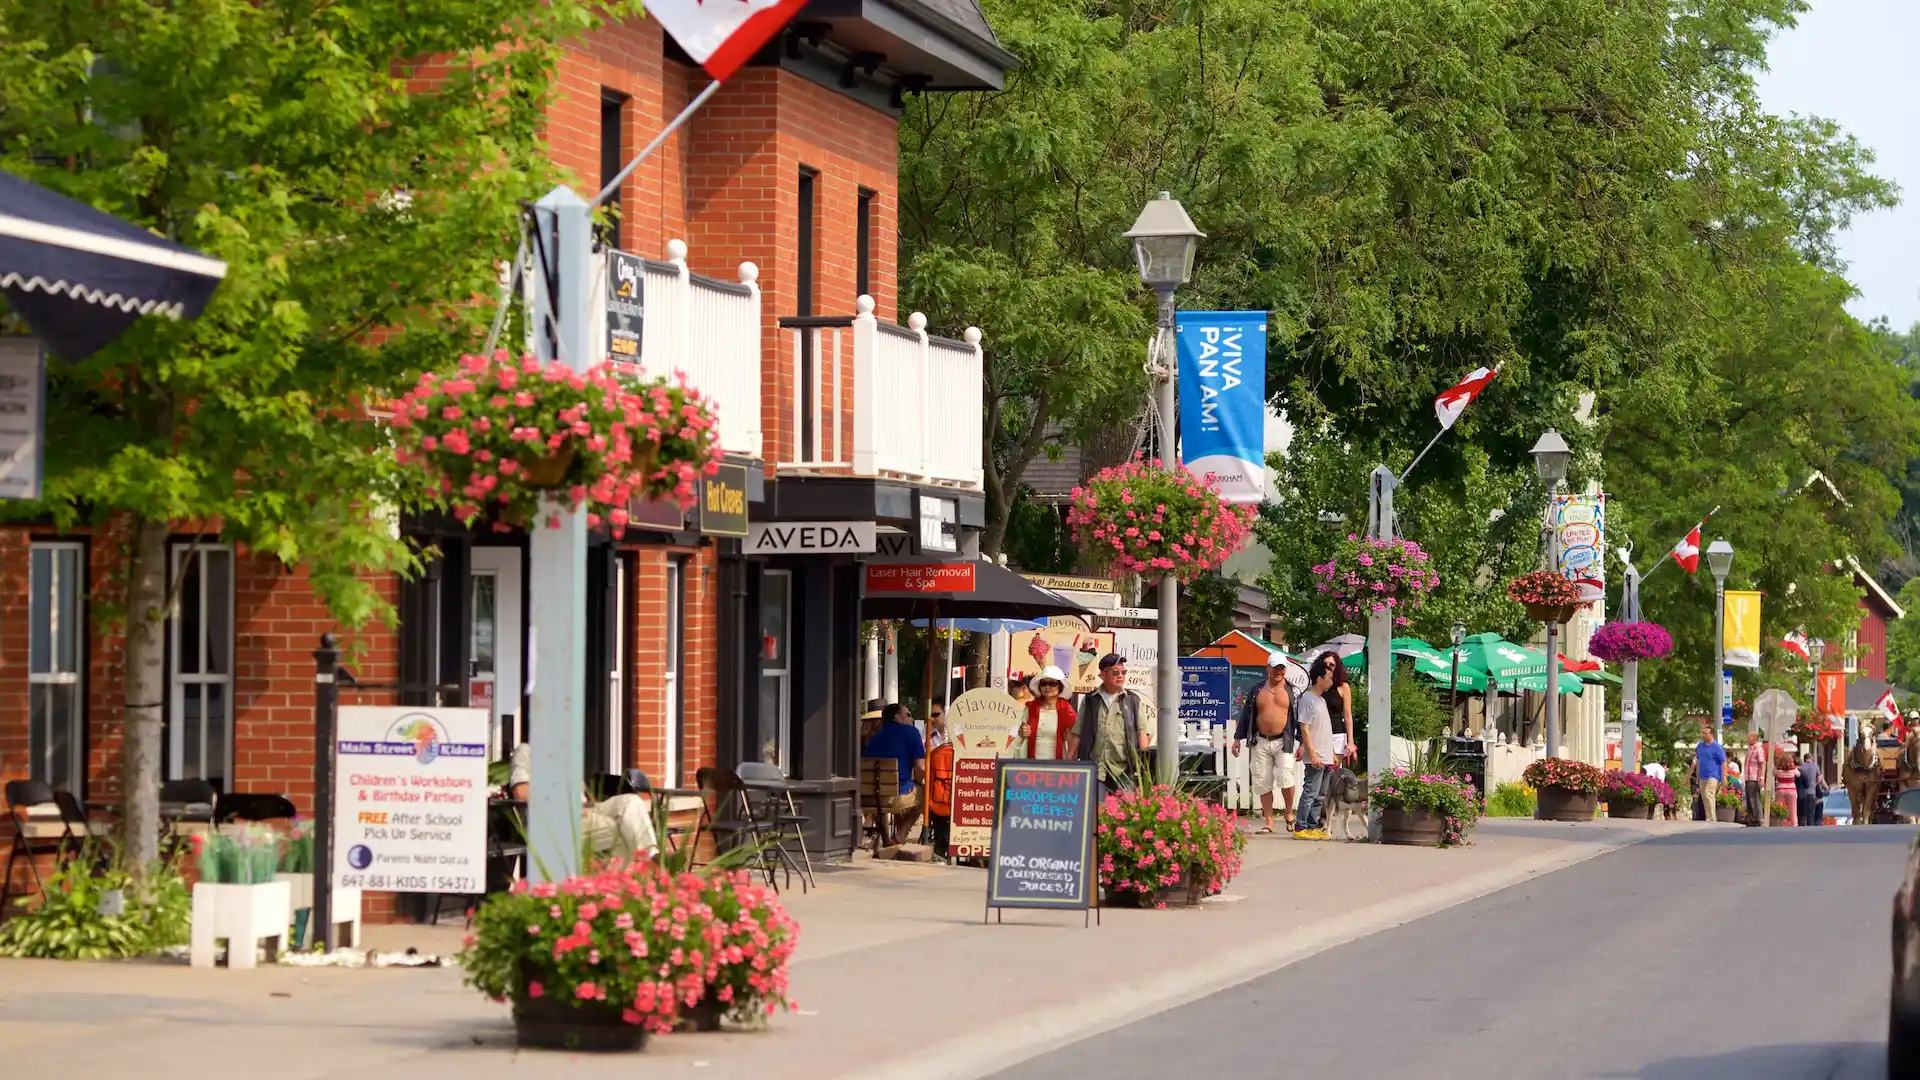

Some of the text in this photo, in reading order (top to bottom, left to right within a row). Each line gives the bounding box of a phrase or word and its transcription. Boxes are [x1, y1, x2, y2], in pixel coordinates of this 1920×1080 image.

[1199, 326, 1220, 433] PAN AM!
[706, 480, 744, 515] Hot Crepes
[756, 526, 861, 549] AVEDA
[870, 567, 971, 578] Laser Hair Removal
[905, 578, 936, 590] & Spa
[1048, 578, 1090, 589] Products
[1093, 580, 1110, 590] Inc.
[1124, 609, 1139, 617] 155
[1049, 617, 1086, 633] lavours
[1501, 665, 1547, 677] MOOSEHEAD LAGE
[1128, 677, 1147, 686] 50%
[1456, 675, 1473, 685] LAGER
[1203, 697, 1226, 707] Easy...
[956, 698, 1018, 720] Flavours
[1179, 709, 1217, 717] 5.477.1454
[964, 723, 1008, 732] Unionville
[340, 743, 372, 754] Main
[373, 743, 416, 755] Street
[961, 762, 980, 770] Gelato
[980, 762, 990, 770] Ice
[349, 774, 473, 789] Children's Workshops
[955, 775, 994, 784] Fresh Frozen
[1015, 770, 1081, 789] OPEN!
[358, 790, 465, 803] & Birthday Parties
[958, 788, 976, 798] Fresh
[975, 788, 990, 798] Fruit
[1006, 788, 1079, 805] EUROPEAN
[961, 802, 975, 811] Soft
[975, 803, 985, 811] Ice
[358, 812, 463, 826] FREE After School
[981, 816, 992, 826] Sco
[1010, 816, 1073, 834] PANINI
[364, 827, 452, 841] Pick Up Service
[957, 845, 991, 857] OPE
[376, 854, 411, 864] Parents
[413, 854, 437, 865] Night
[1028, 856, 1082, 873] ORGANIC
[341, 875, 476, 890] 647-881-KIDS (5437)
[1018, 881, 1075, 897] JUICES!!
